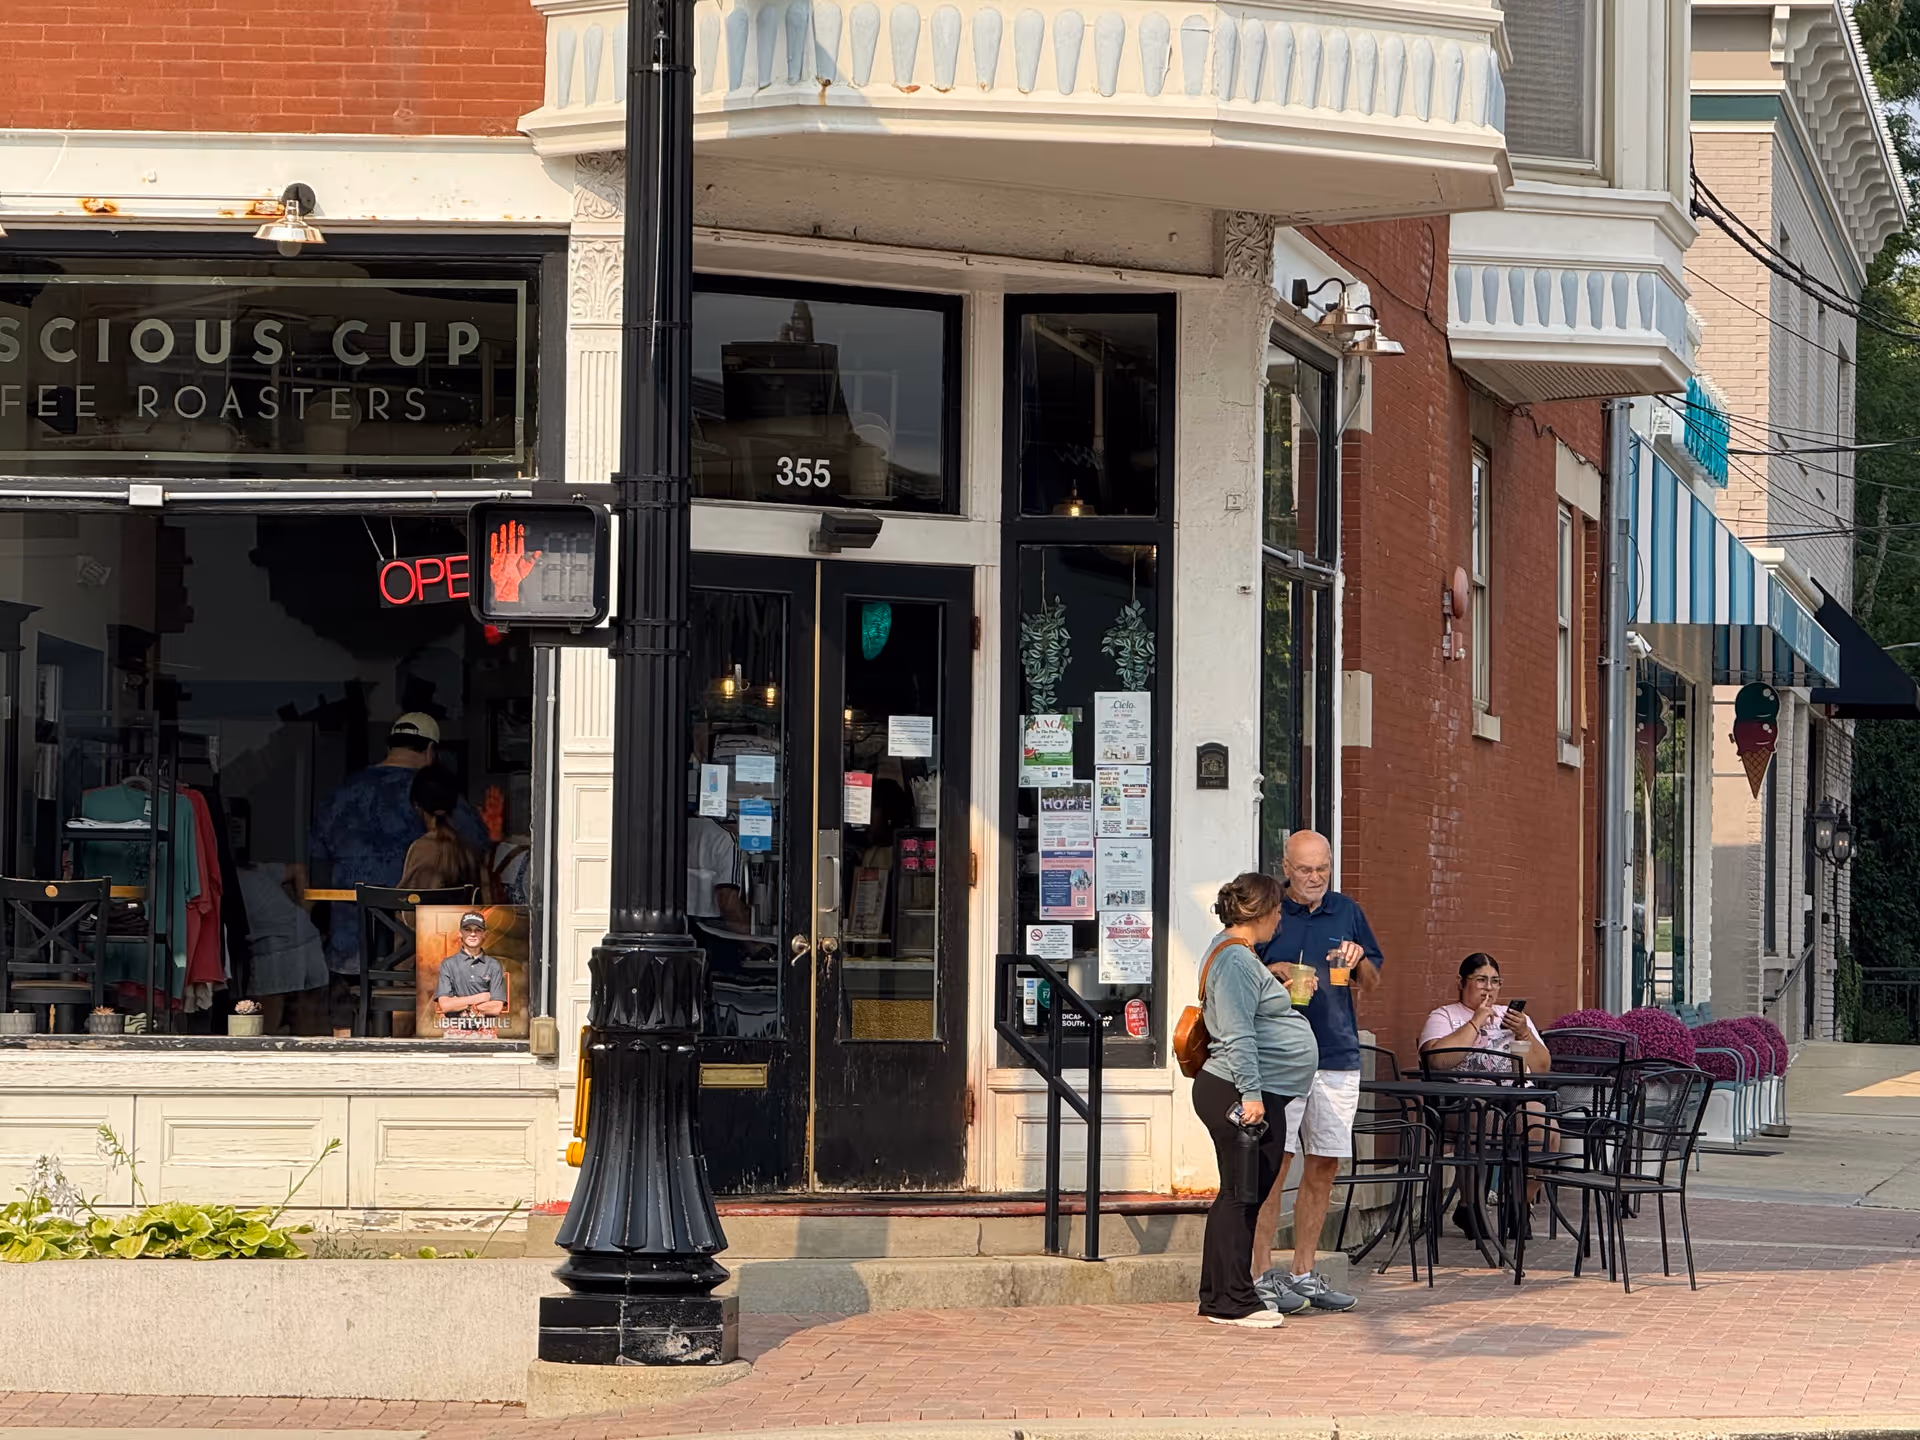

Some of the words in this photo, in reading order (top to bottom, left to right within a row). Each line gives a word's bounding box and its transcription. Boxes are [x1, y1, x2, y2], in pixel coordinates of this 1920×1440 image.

[0, 316, 284, 364] SCIOUS
[332, 320, 483, 367] CUP
[1, 384, 97, 417] FEE
[138, 386, 427, 421] ROASTERS
[776, 456, 831, 488] 355
[379, 554, 470, 605] OPE
[433, 1017, 511, 1030] LIBERTYVILLE
